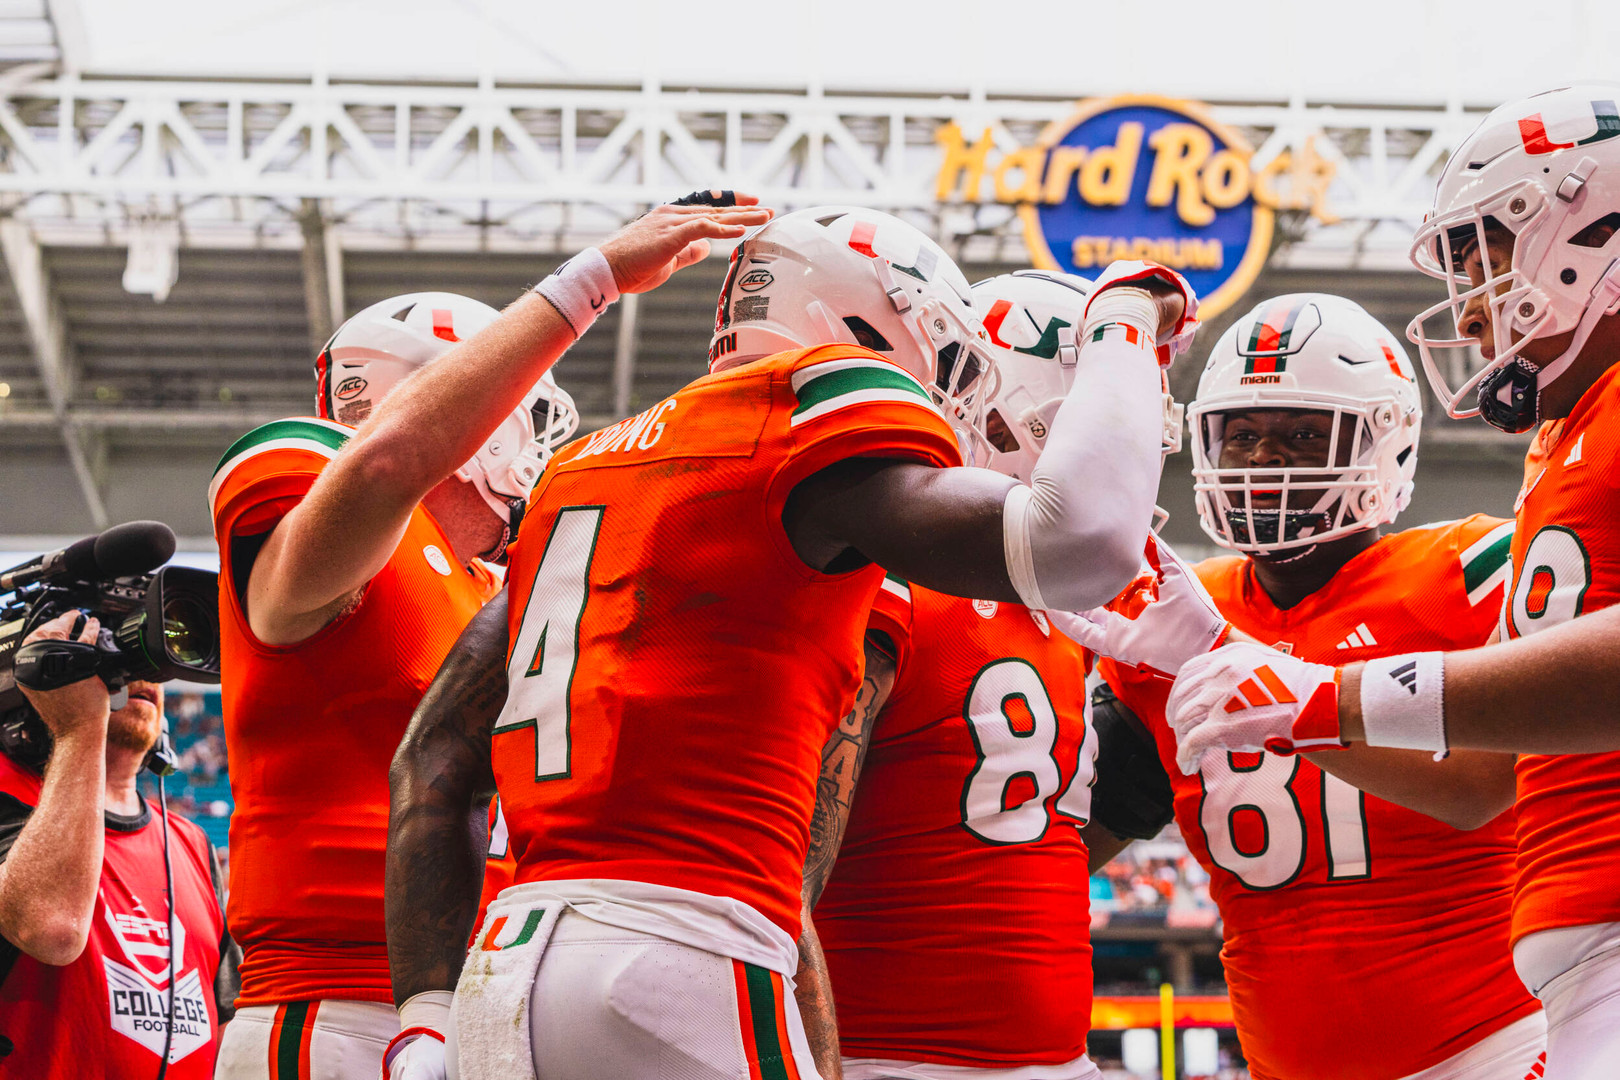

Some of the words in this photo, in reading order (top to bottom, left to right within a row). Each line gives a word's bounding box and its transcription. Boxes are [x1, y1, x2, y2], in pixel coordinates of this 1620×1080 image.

[934, 119, 1144, 206] Hard
[1148, 122, 1341, 226] Rock
[1071, 236, 1224, 270] STADIUM
[1240, 374, 1281, 385] miami
[491, 504, 606, 783] 4
[113, 989, 207, 1025] COLLEGE
[133, 1018, 201, 1037] FOOTBALL
